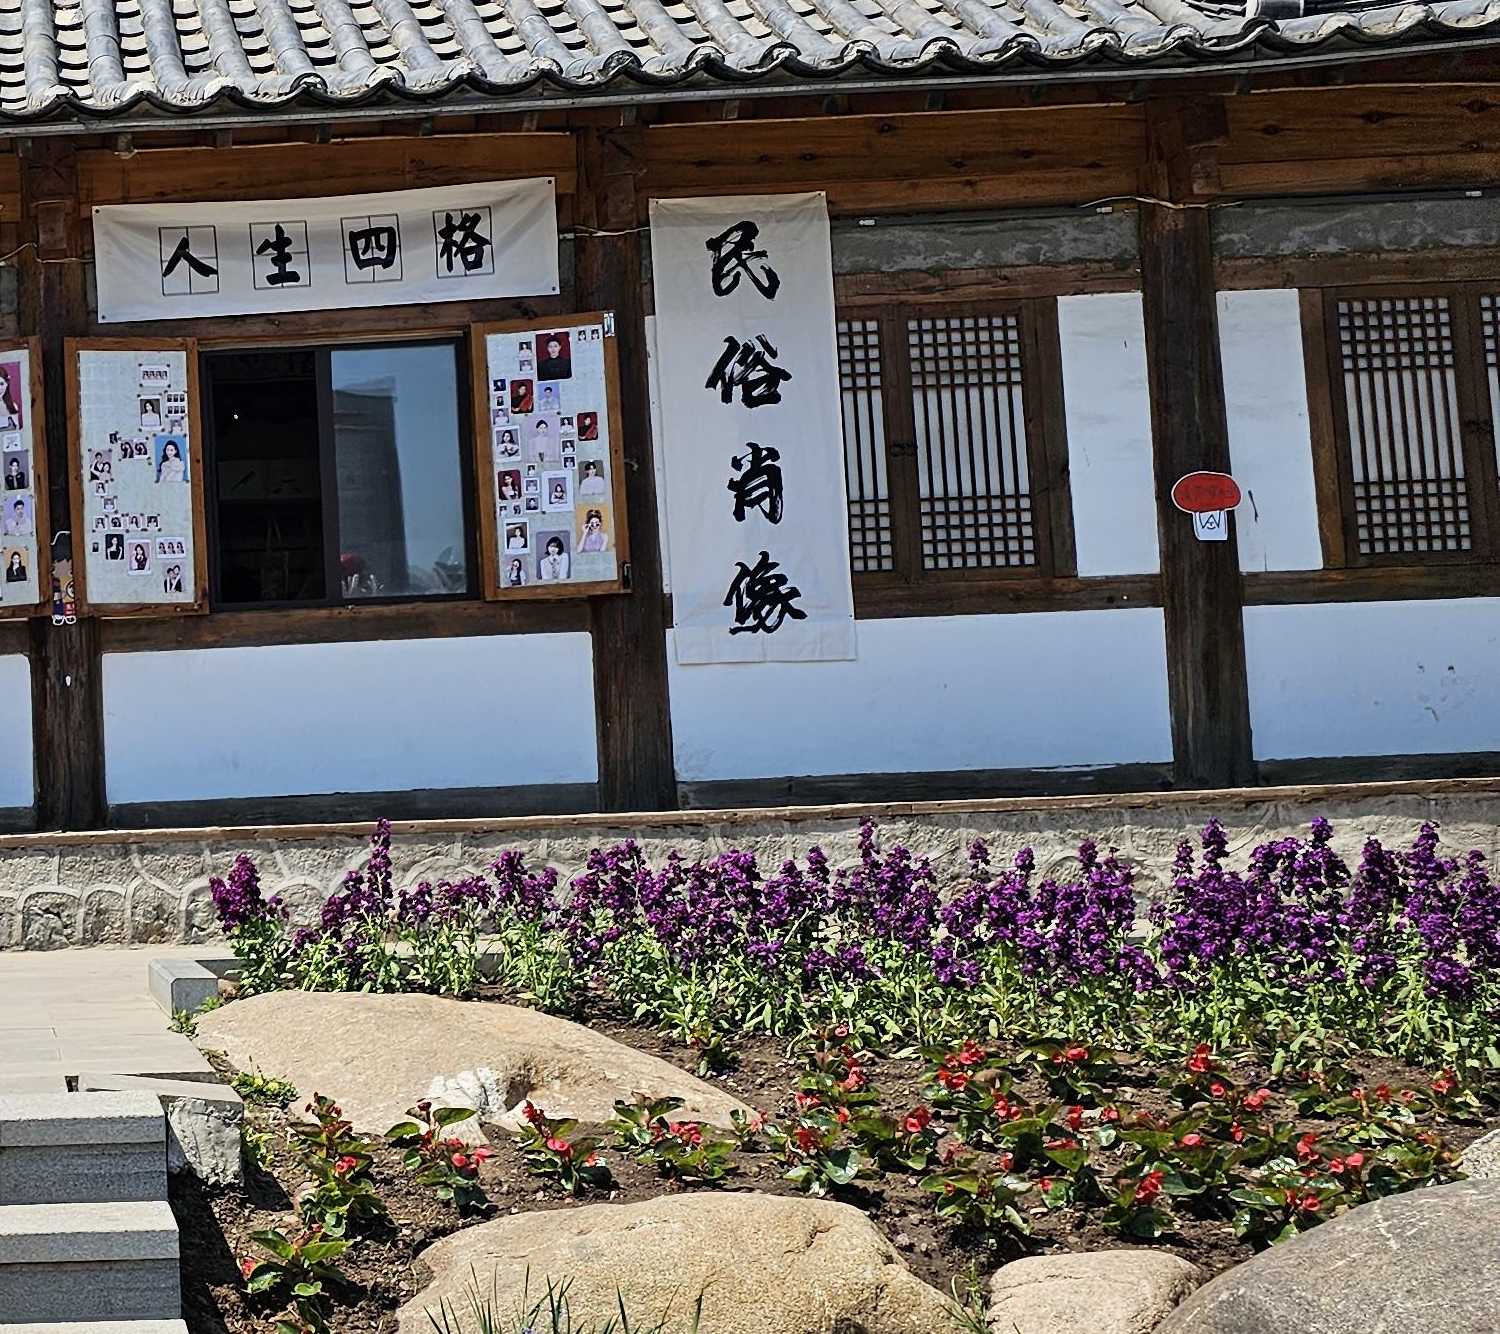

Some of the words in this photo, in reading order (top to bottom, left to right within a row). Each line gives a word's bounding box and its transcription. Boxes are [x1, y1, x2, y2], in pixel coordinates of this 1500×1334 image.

[162, 211, 492, 285] 人生四格
[705, 219, 808, 636] 民俗肖像
